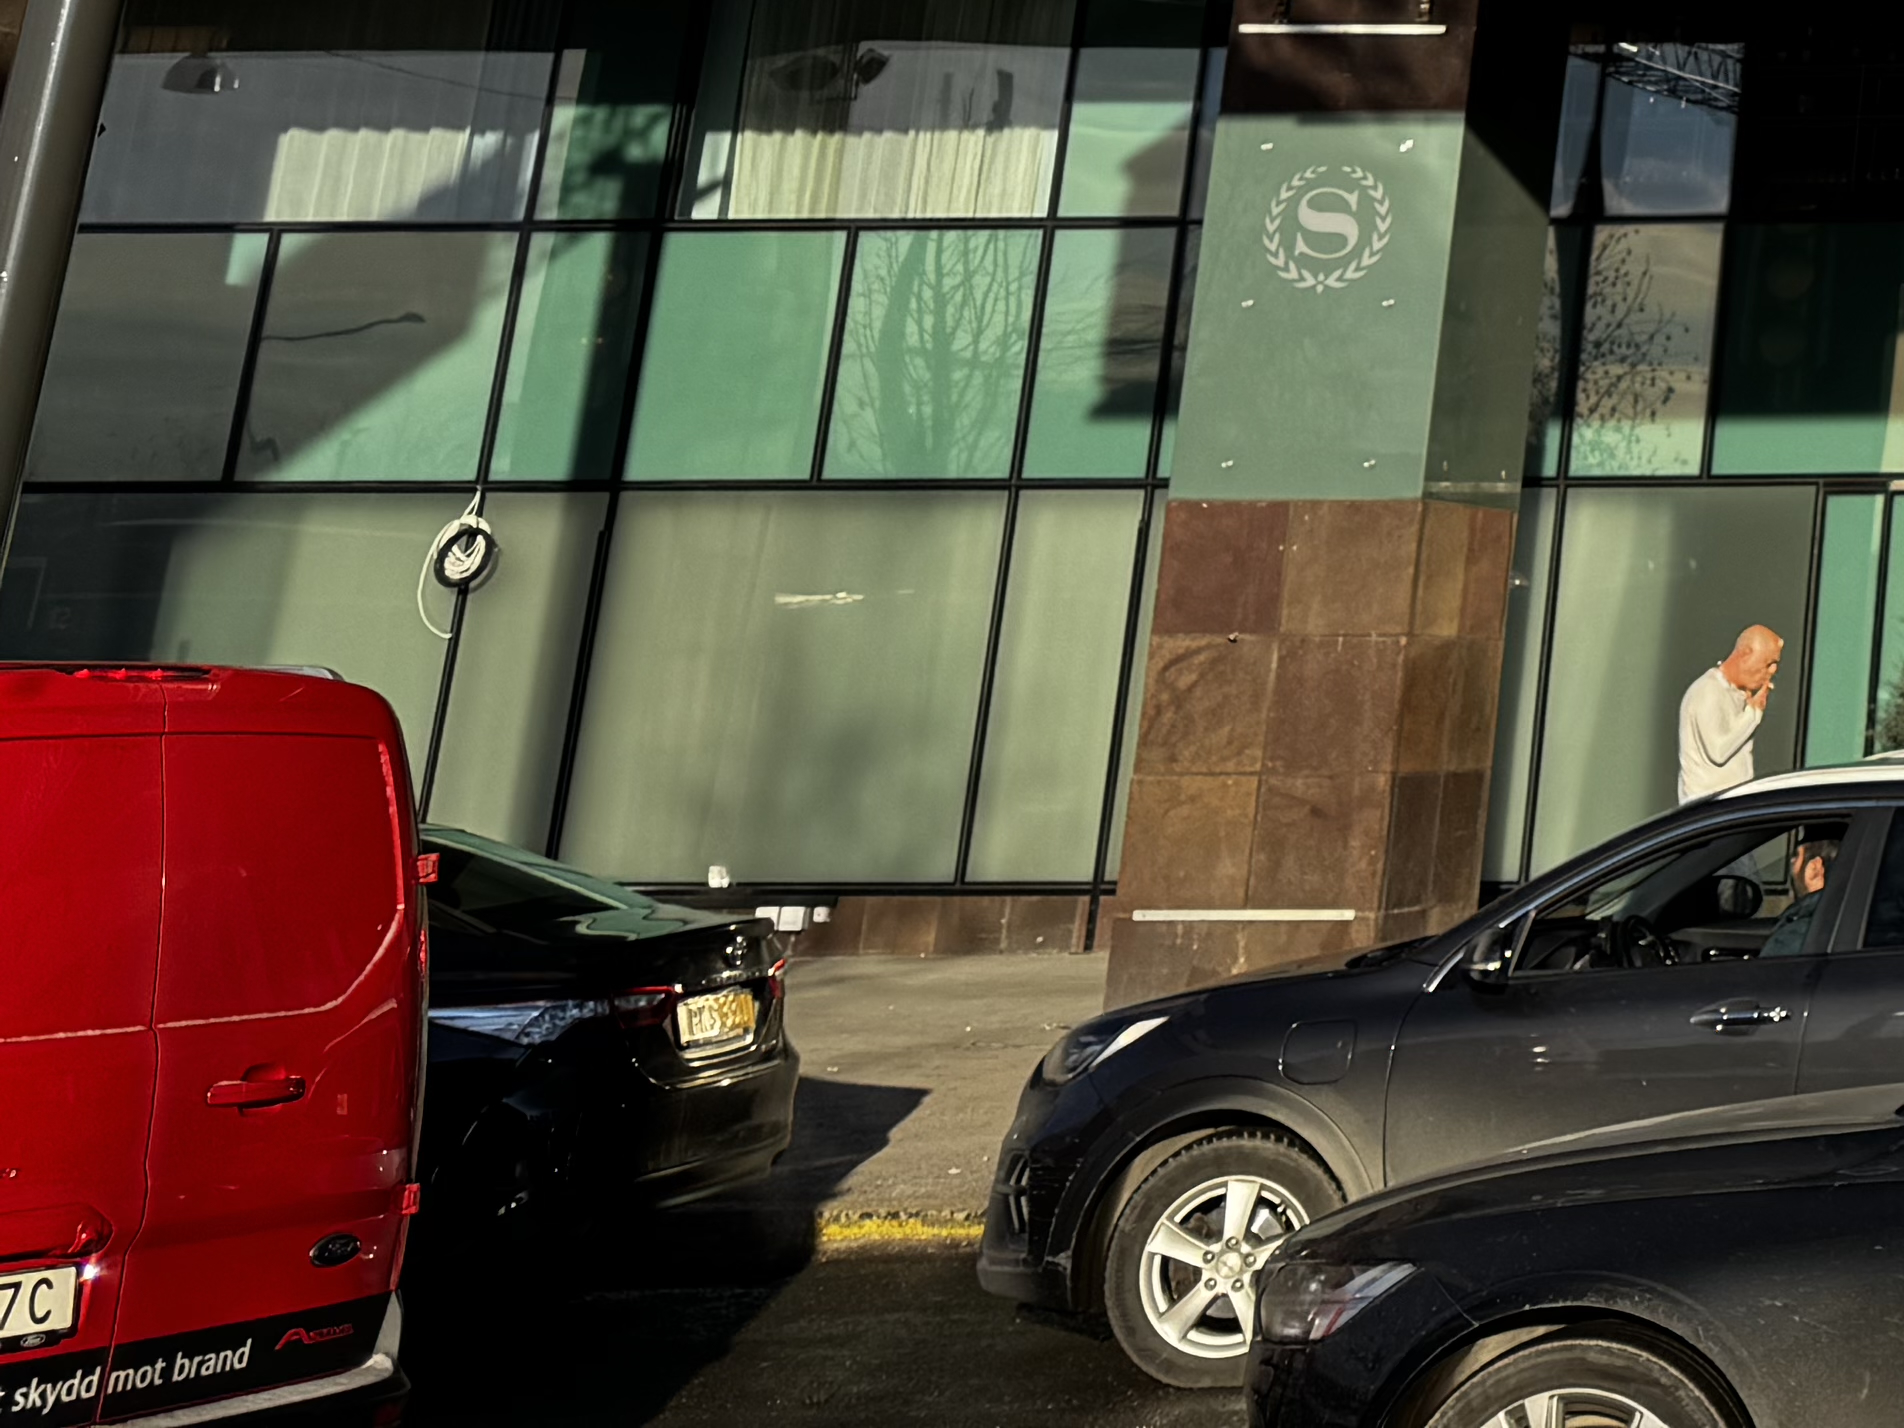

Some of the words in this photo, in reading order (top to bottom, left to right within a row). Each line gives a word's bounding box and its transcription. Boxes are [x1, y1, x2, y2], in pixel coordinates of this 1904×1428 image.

[1294, 187, 1359, 259] S
[12, 1367, 102, 1415] skydd
[107, 1360, 166, 1394] mot
[172, 1339, 252, 1382] brand
